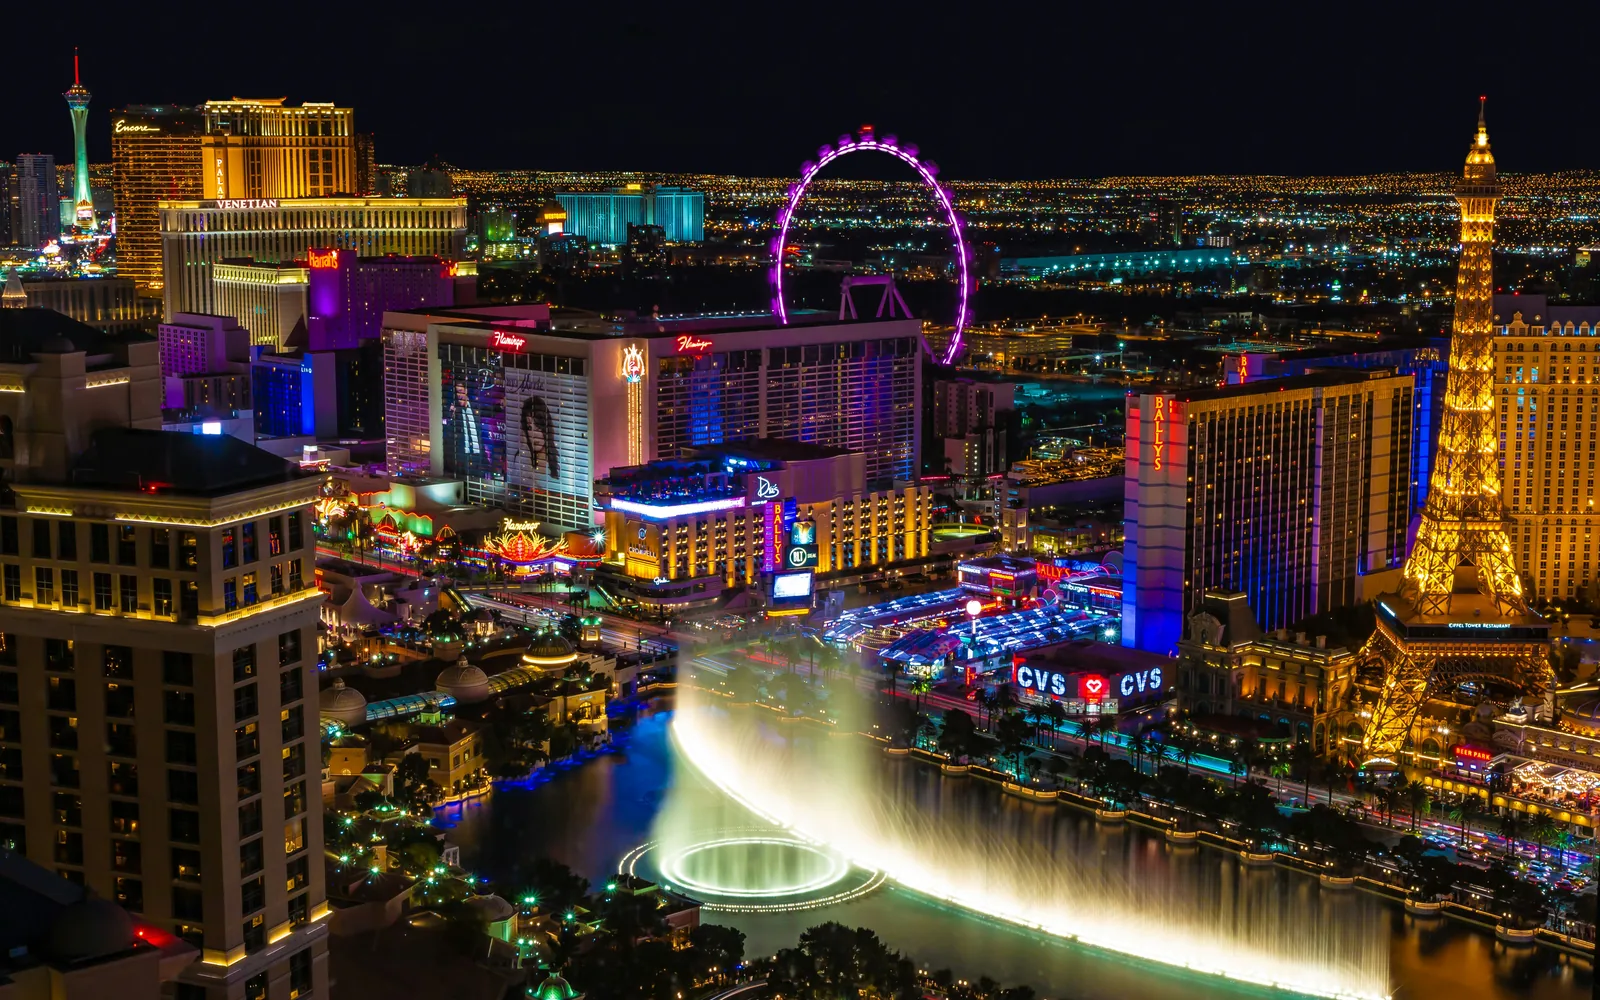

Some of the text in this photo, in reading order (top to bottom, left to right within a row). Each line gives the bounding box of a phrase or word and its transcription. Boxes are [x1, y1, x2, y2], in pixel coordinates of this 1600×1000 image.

[115, 119, 160, 133] Encore
[217, 199, 278, 209] VENETIAN
[493, 331, 526, 350] Flamingo
[677, 335, 713, 352] Flamingo
[1153, 396, 1164, 471] BALLYS
[503, 517, 541, 534] Flamingo
[773, 504, 782, 564] BALLYS
[1035, 561, 1071, 578] BALLY'S
[1017, 665, 1066, 696] CVS
[1121, 667, 1161, 696] CVS
[1456, 747, 1491, 761] BEER PARK
